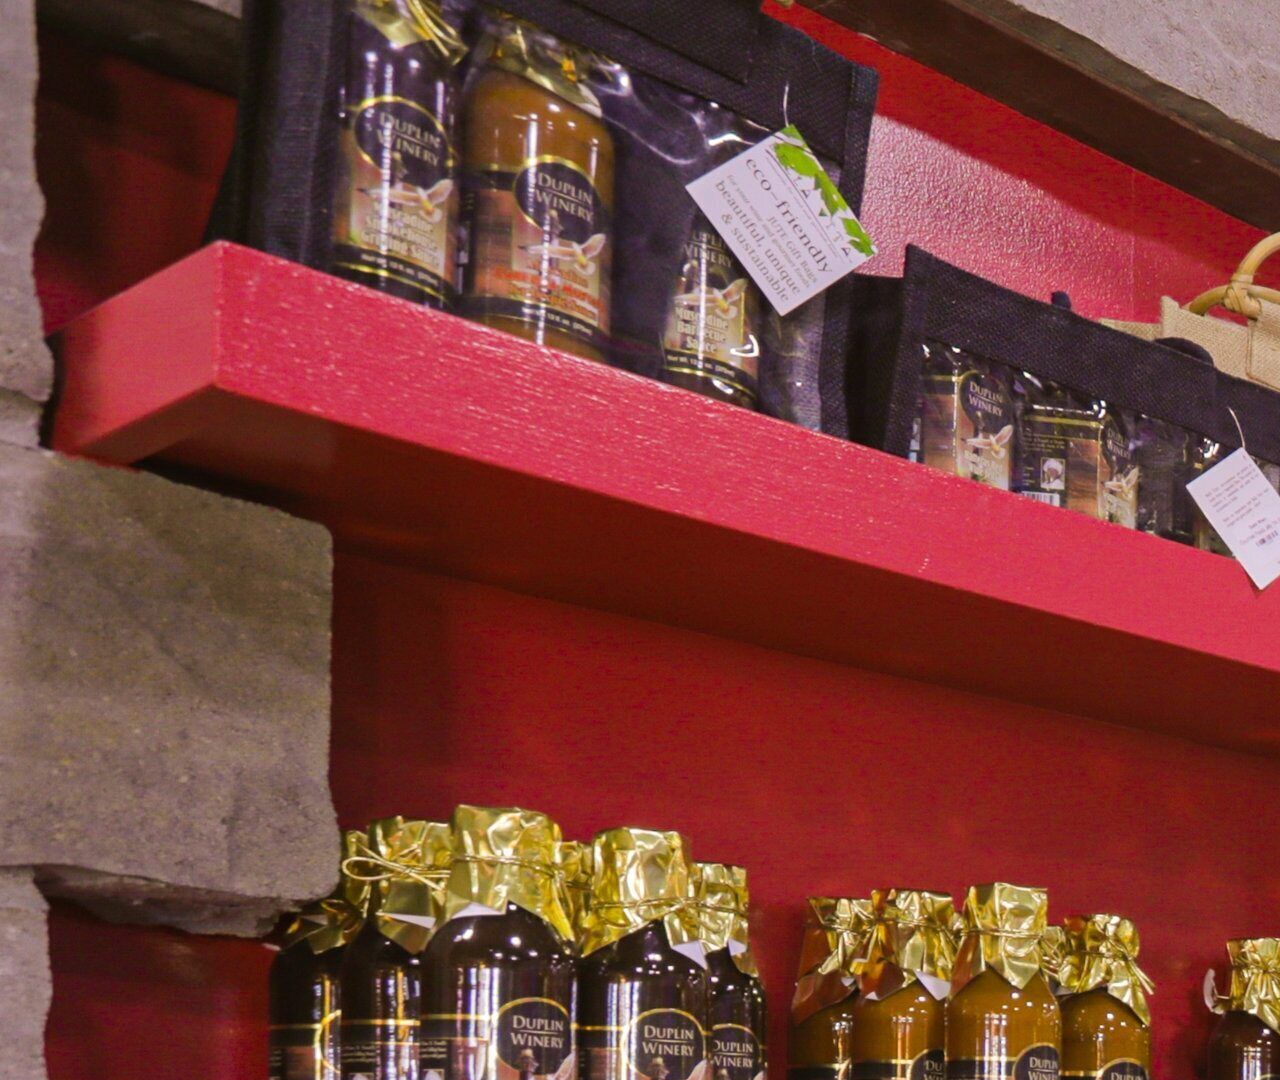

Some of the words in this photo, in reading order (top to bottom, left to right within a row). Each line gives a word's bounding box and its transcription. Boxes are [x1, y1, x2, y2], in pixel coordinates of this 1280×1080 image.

[379, 112, 442, 149] DUPLIN
[536, 172, 594, 205] DUPLIN
[534, 189, 594, 225] WINERY
[730, 224, 792, 303] sustainable
[762, 246, 803, 297] unique
[512, 1015, 564, 1032] DUPLIN
[644, 1025, 694, 1040] DUPLIN
[510, 1032, 564, 1049] WINERY
[642, 1041, 694, 1057] WINERY
